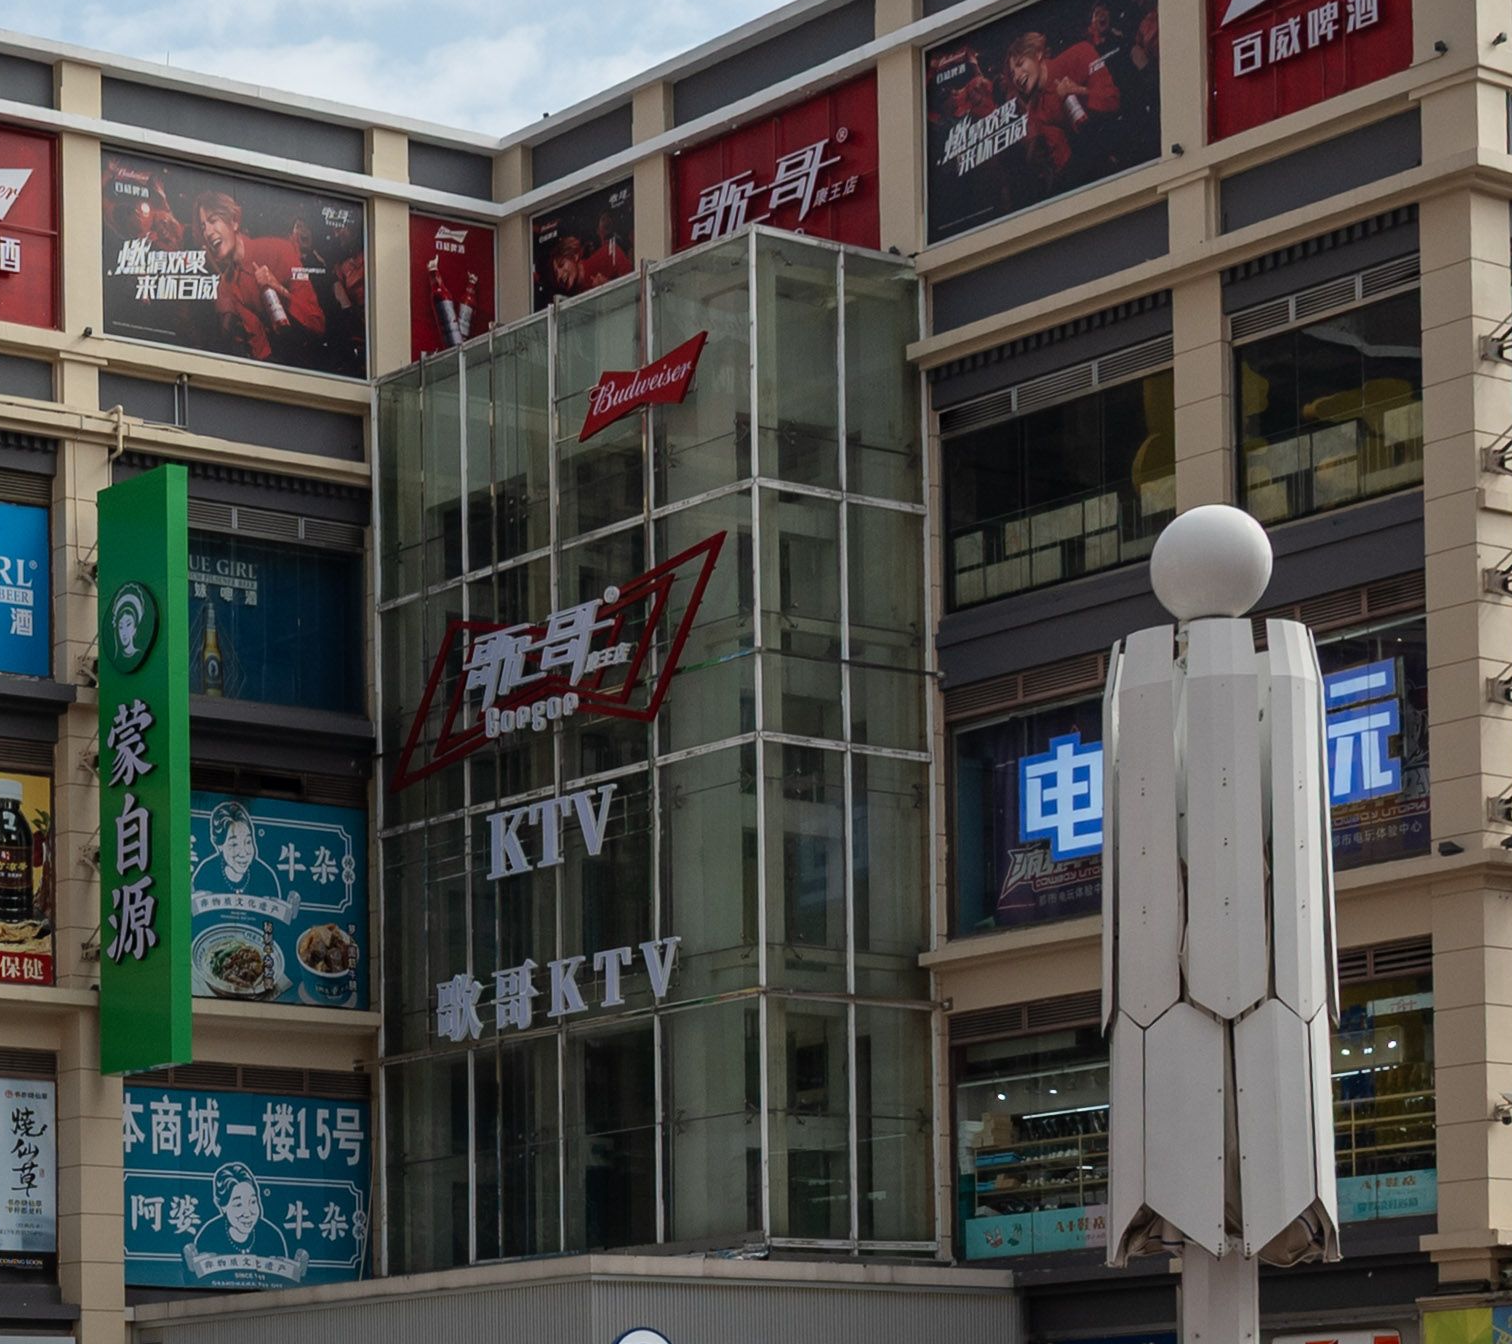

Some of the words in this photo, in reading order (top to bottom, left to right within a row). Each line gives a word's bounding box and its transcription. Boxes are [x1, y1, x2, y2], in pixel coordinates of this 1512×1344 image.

[936, 96, 1018, 168] 燃情欢聚
[958, 113, 1029, 178] 来杯百威
[688, 138, 842, 240] 歌哥
[812, 174, 859, 209] 康王店
[115, 236, 207, 276] 燃情欢聚
[136, 274, 219, 301] 来杯百威
[588, 360, 694, 419] Budweiser
[107, 698, 159, 965] 蒙自源
[486, 783, 618, 881] KTV
[276, 842, 341, 887] 牛杂
[123, 1092, 365, 1167] 本商城一楼15号
[129, 1194, 203, 1235] 阿婆
[282, 1200, 349, 1242] 牛杂
